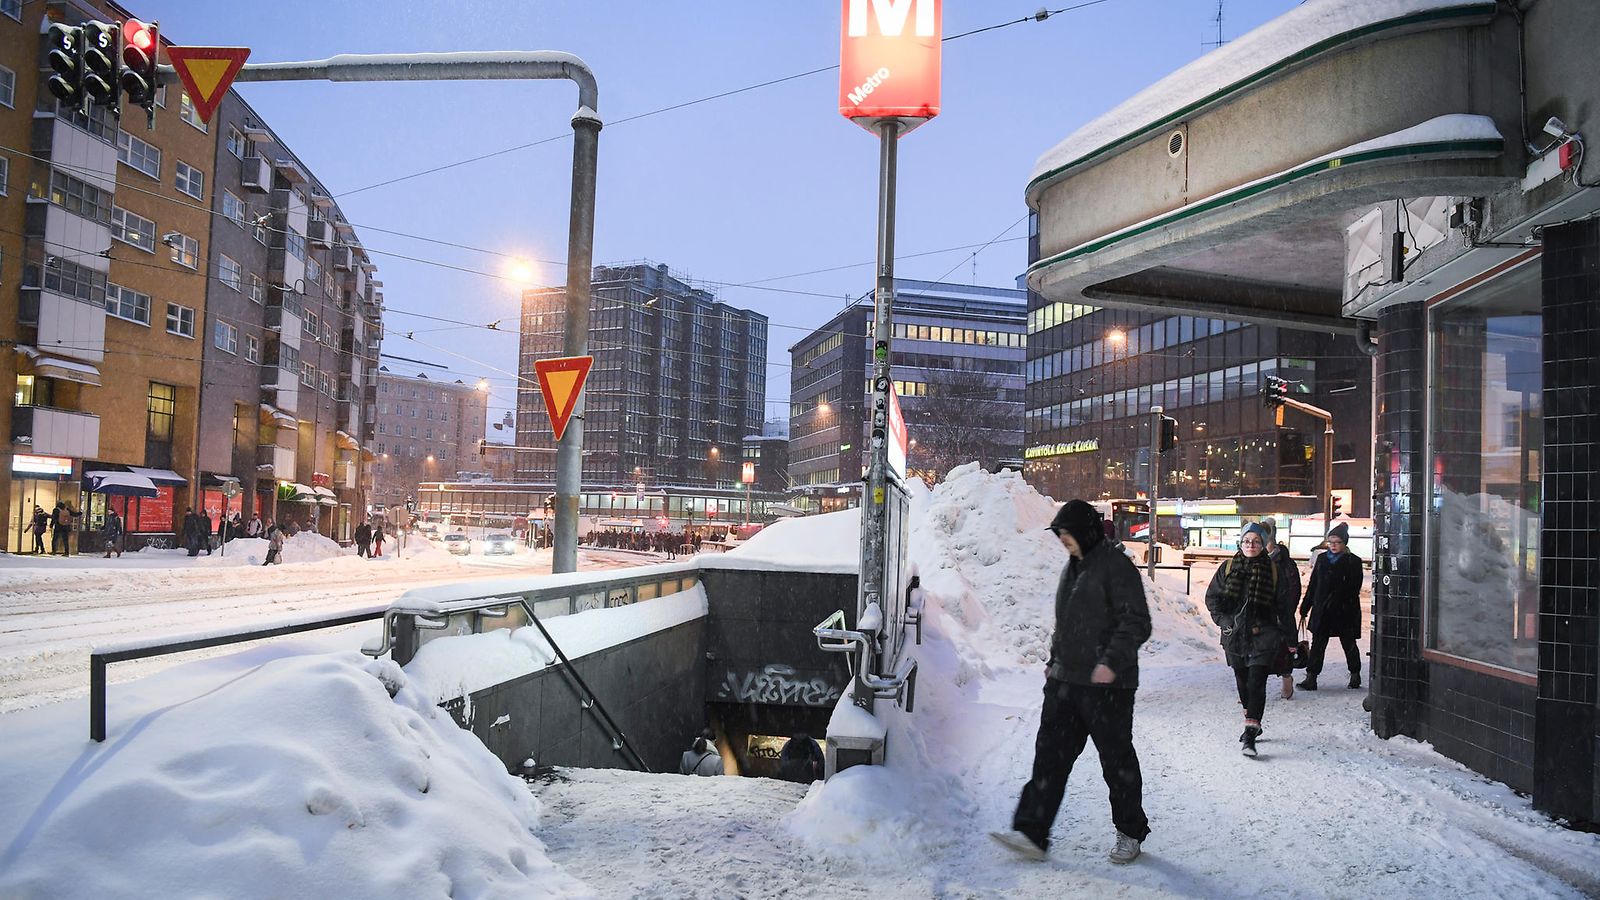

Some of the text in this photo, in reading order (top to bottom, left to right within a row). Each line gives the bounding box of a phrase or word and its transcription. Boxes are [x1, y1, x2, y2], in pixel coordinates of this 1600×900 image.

[63, 36, 72, 50] S
[98, 32, 108, 48] S
[847, 67, 890, 106] Metro
